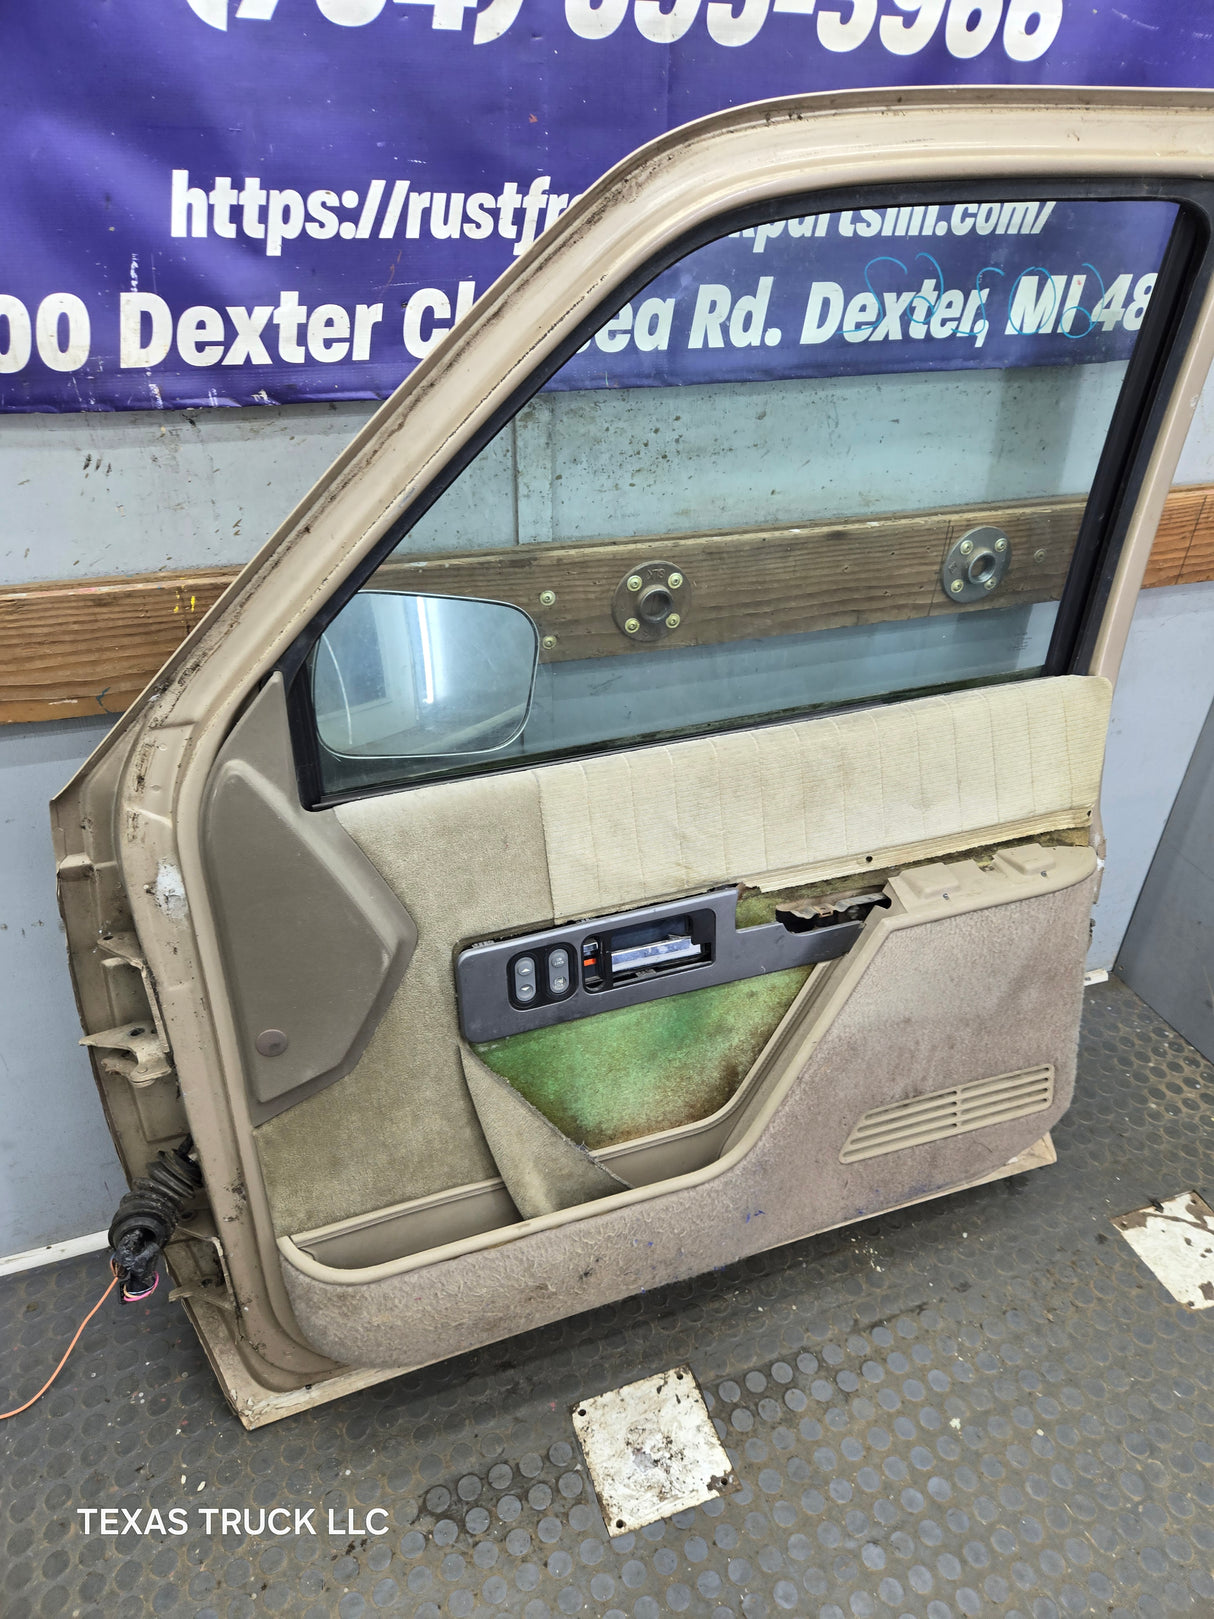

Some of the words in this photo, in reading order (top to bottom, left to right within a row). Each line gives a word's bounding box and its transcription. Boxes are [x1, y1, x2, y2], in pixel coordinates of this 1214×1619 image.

[119, 291, 383, 369] Dexter
[687, 276, 782, 349] Rd.
[799, 279, 990, 348] Dexter,
[1004, 274, 1086, 335] MI
